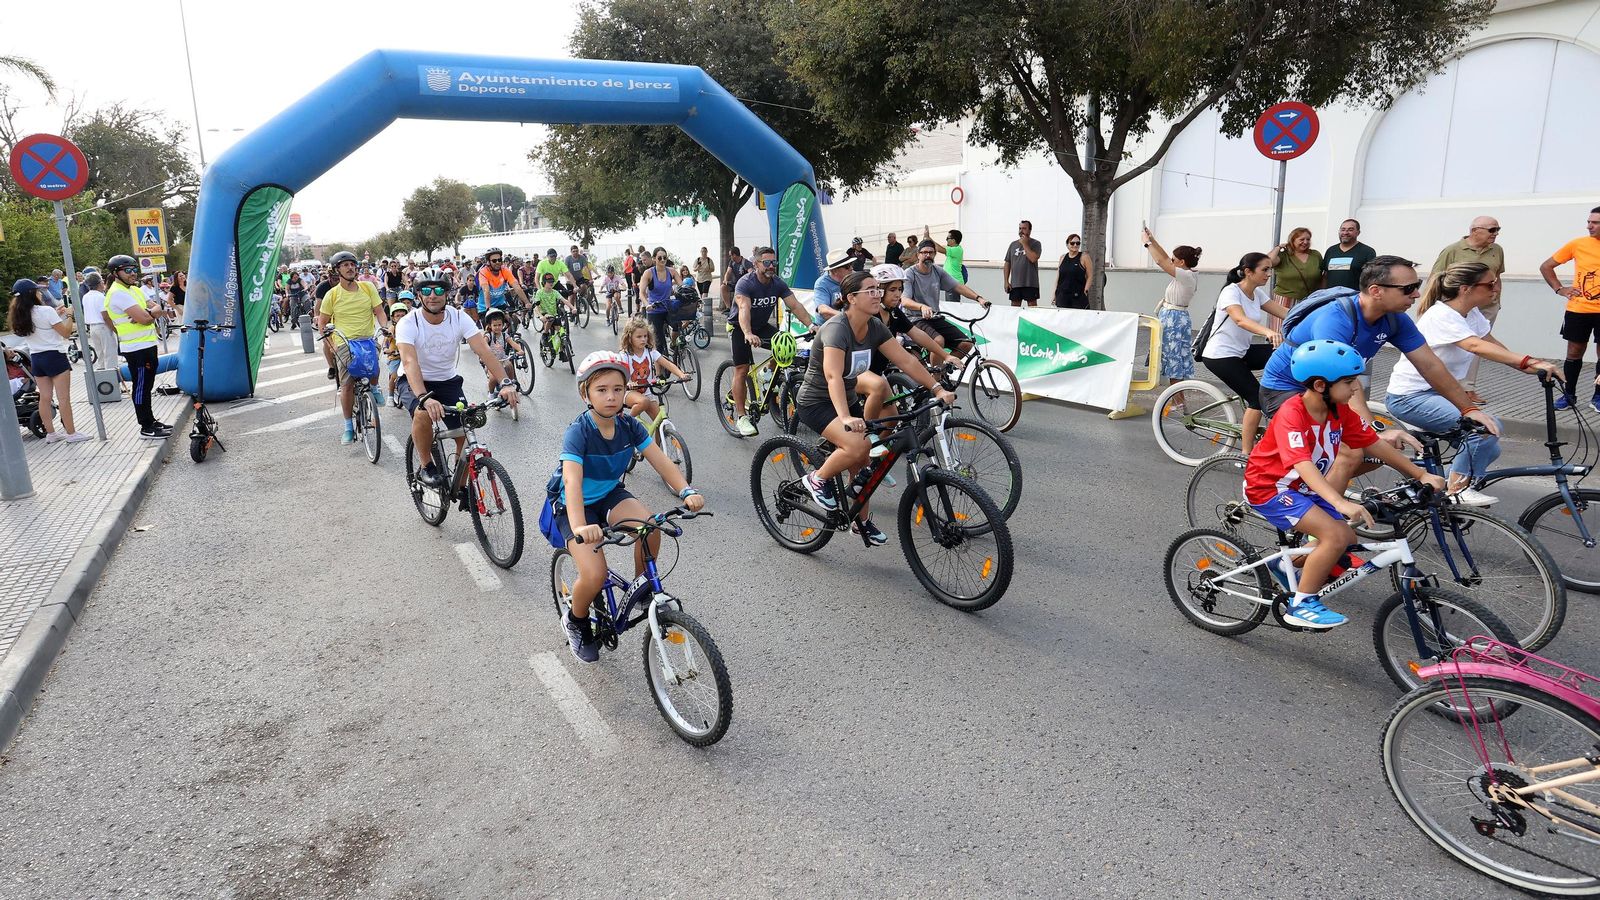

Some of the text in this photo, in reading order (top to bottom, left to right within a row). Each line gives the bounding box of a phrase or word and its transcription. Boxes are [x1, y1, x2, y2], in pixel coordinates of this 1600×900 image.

[458, 71, 673, 91] Ayuntamiento de Jerez
[458, 84, 526, 95] Deportes
[137, 246, 164, 254] PEATONES
[785, 239, 798, 266] Corte
[752, 295, 776, 305] IZOD
[1020, 342, 1088, 366] El Corte Inglés
